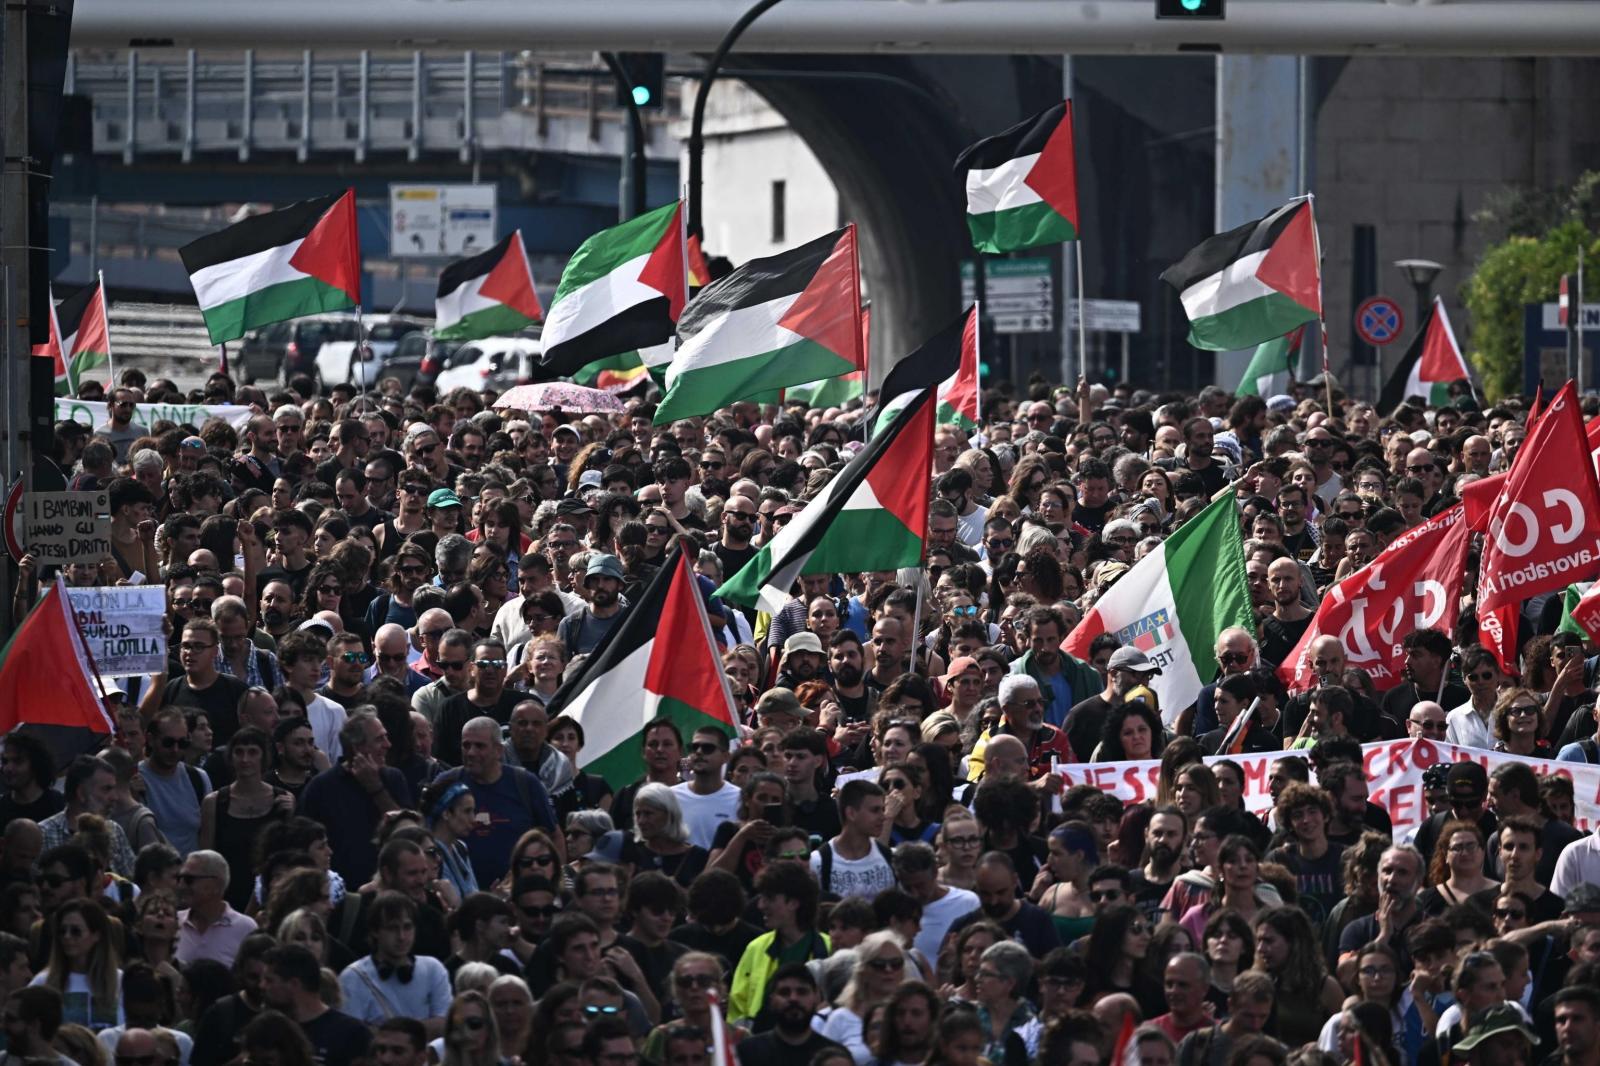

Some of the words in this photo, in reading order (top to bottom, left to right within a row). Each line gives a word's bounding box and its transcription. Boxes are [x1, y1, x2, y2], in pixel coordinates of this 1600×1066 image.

[33, 500, 38, 520] I
[43, 499, 93, 519] BAMBINI
[28, 523, 64, 538] HANNO
[75, 521, 94, 534] GLI
[30, 542, 68, 558] STESSI
[68, 538, 110, 557] DIRITTI
[125, 592, 145, 607] LA
[78, 611, 106, 625] BAL
[80, 624, 130, 639] SUMUD
[103, 638, 159, 657] FLOTILLA
[1363, 738, 1439, 783] CRO
